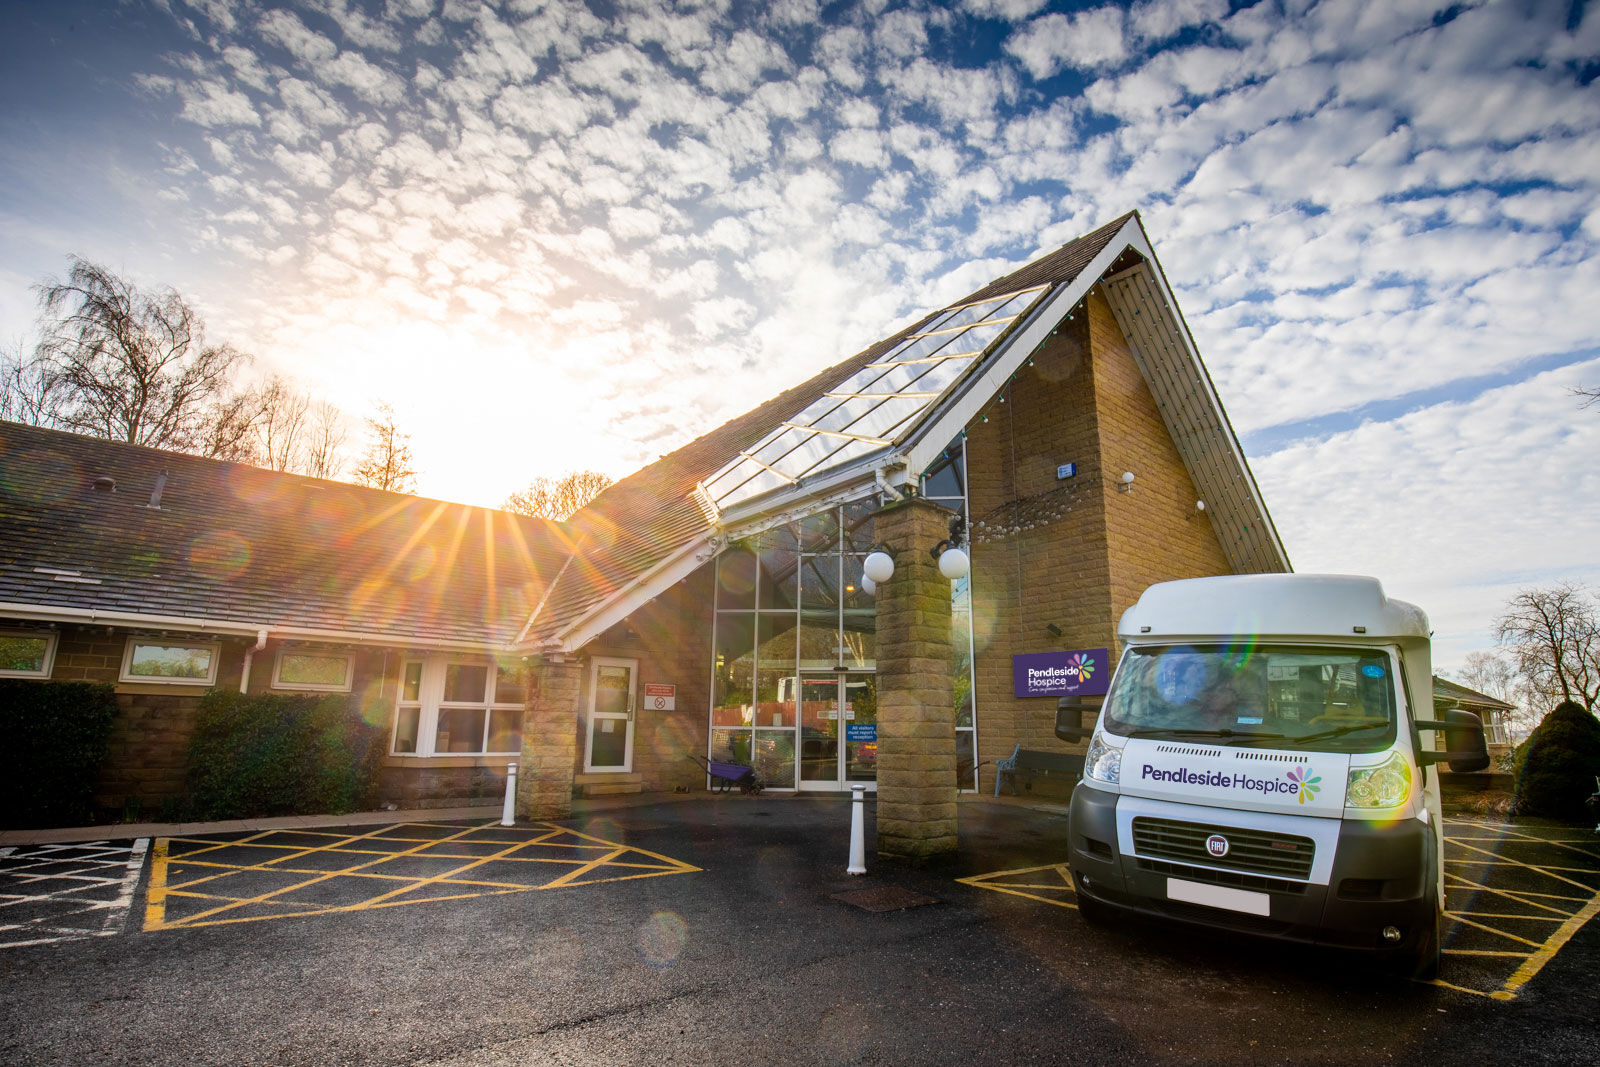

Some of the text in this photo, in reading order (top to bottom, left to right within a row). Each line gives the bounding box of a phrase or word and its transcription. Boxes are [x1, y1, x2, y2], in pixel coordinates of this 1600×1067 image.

[1028, 666, 1079, 677] Pendleside
[1028, 677, 1066, 687] Hospice
[1142, 764, 1298, 795] Pendleside Hospice
[1211, 840, 1225, 852] FIAT
